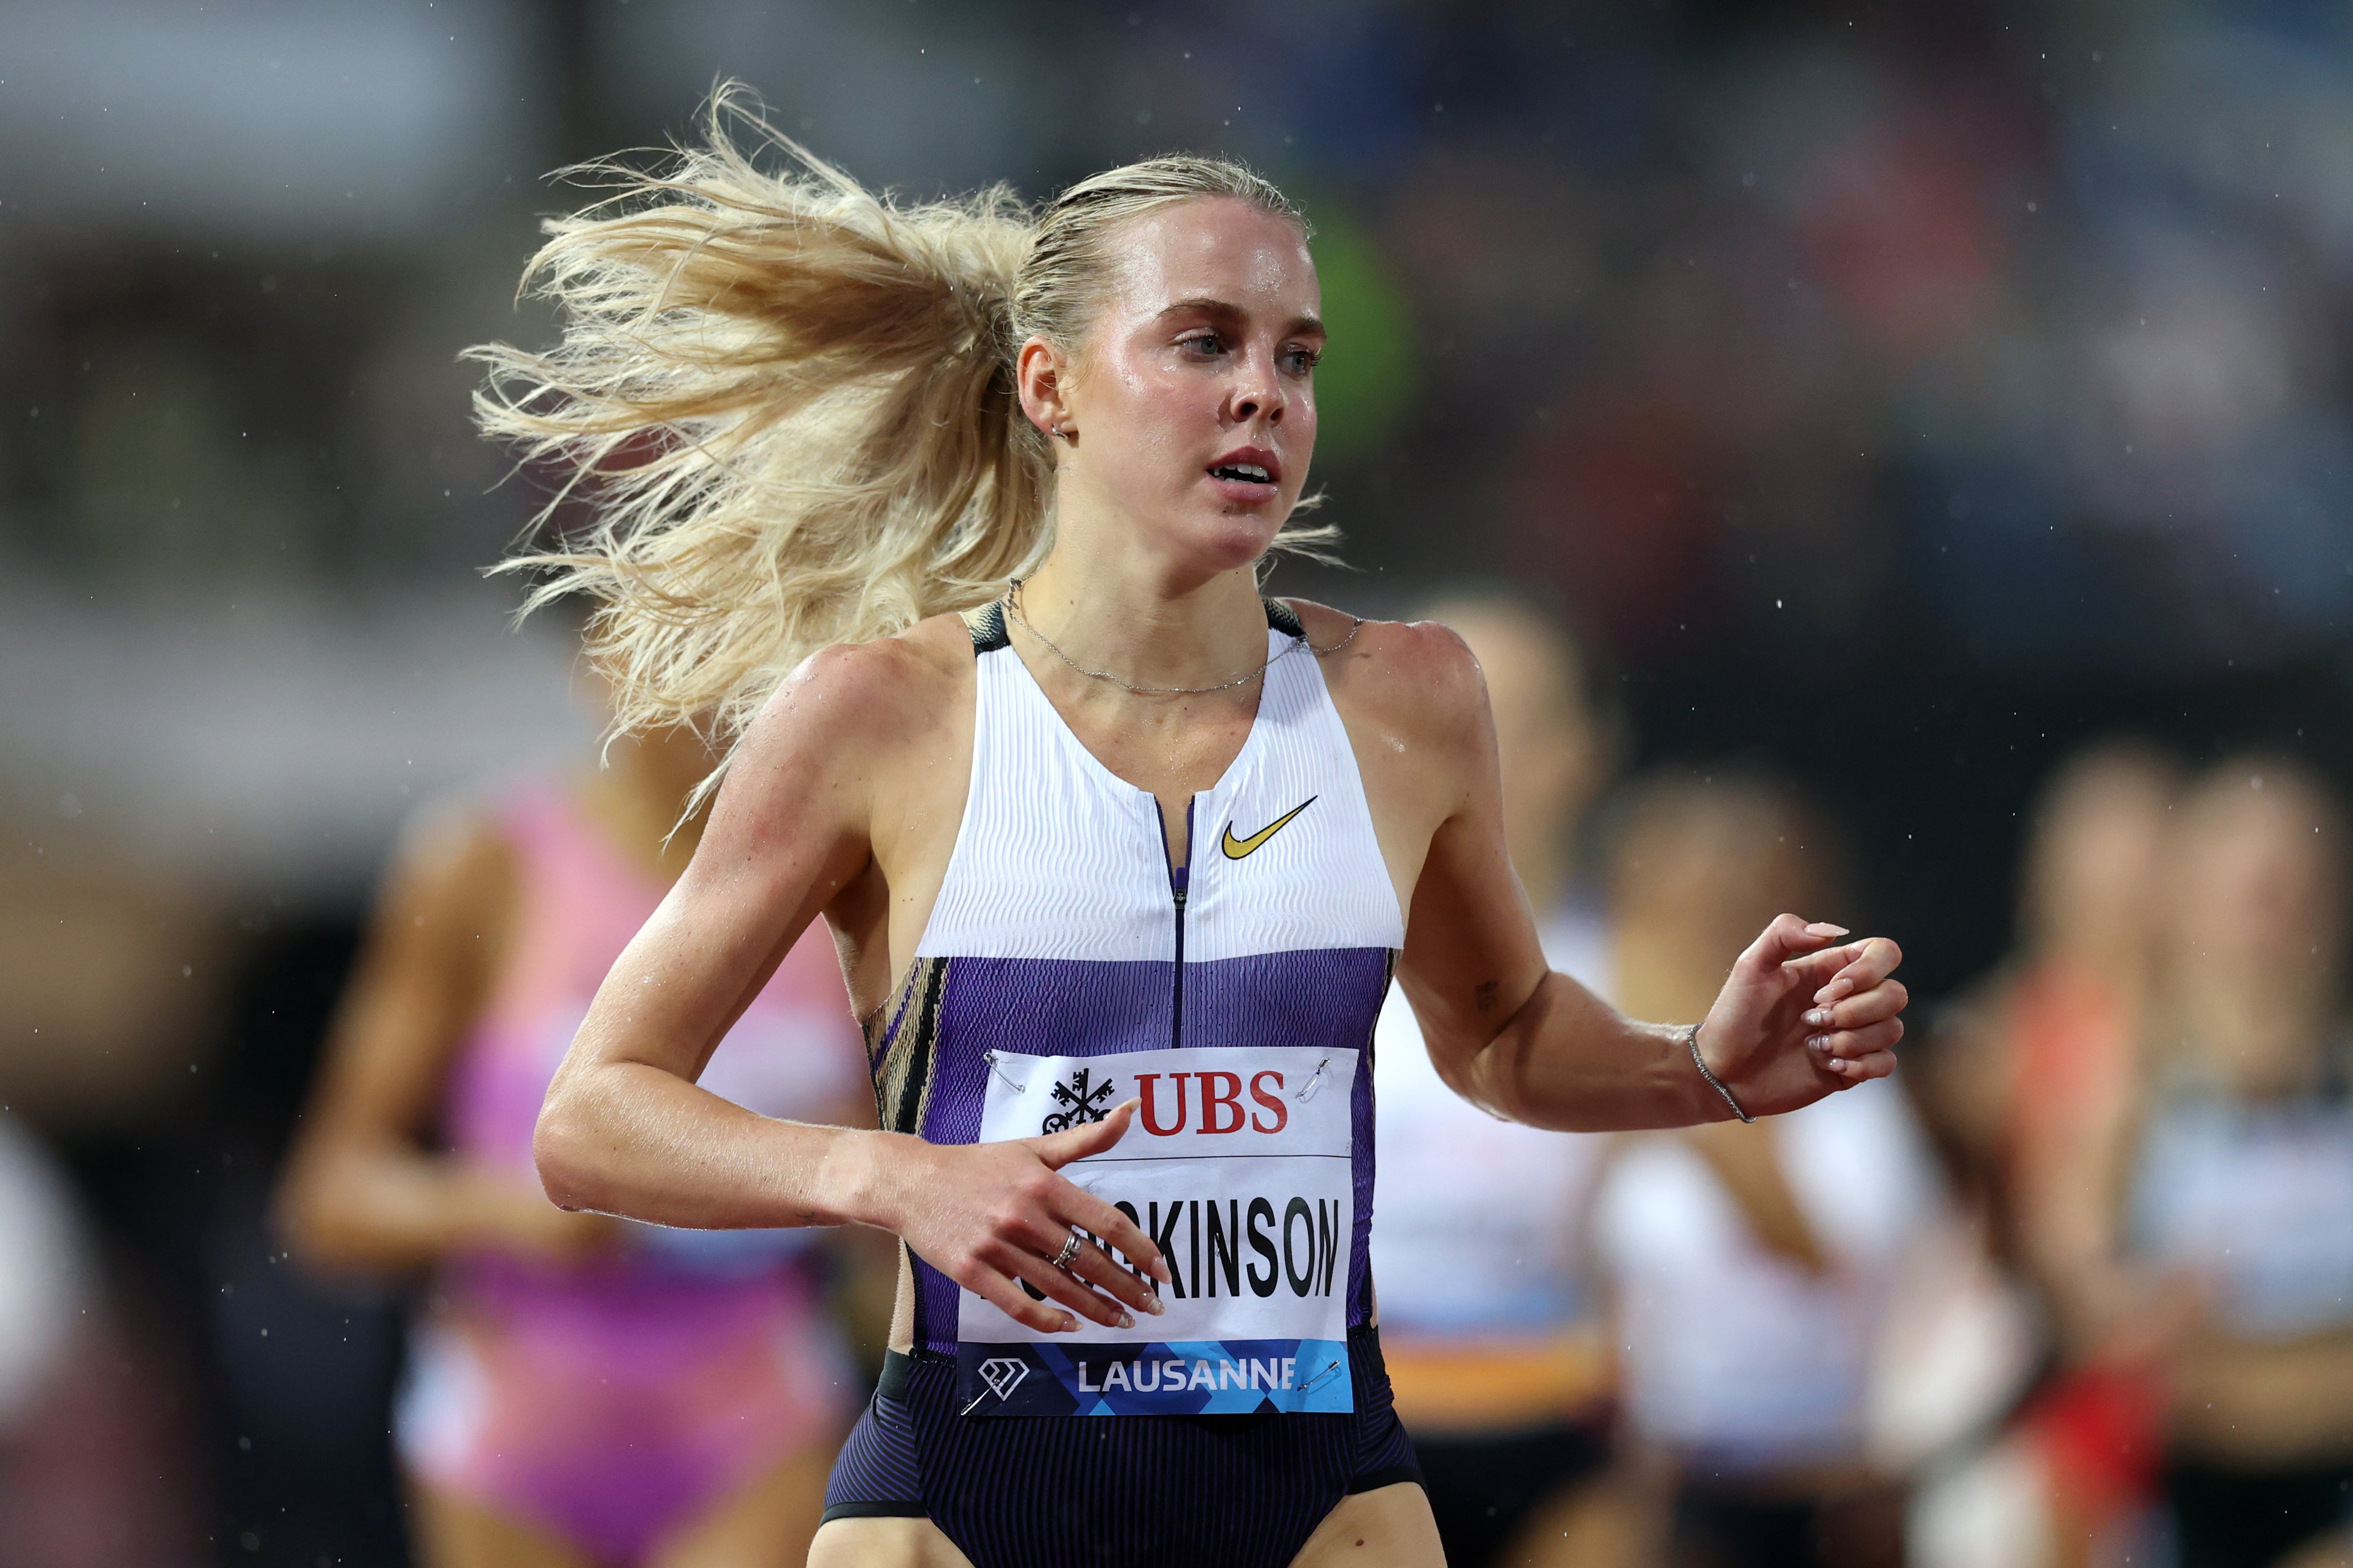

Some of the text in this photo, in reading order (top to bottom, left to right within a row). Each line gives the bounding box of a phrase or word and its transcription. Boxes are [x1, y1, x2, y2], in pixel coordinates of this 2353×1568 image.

[1134, 1071, 1288, 1136] UBS
[981, 1196, 1339, 1302] KINSON
[1078, 1357, 1297, 1393] LAUSANNE
